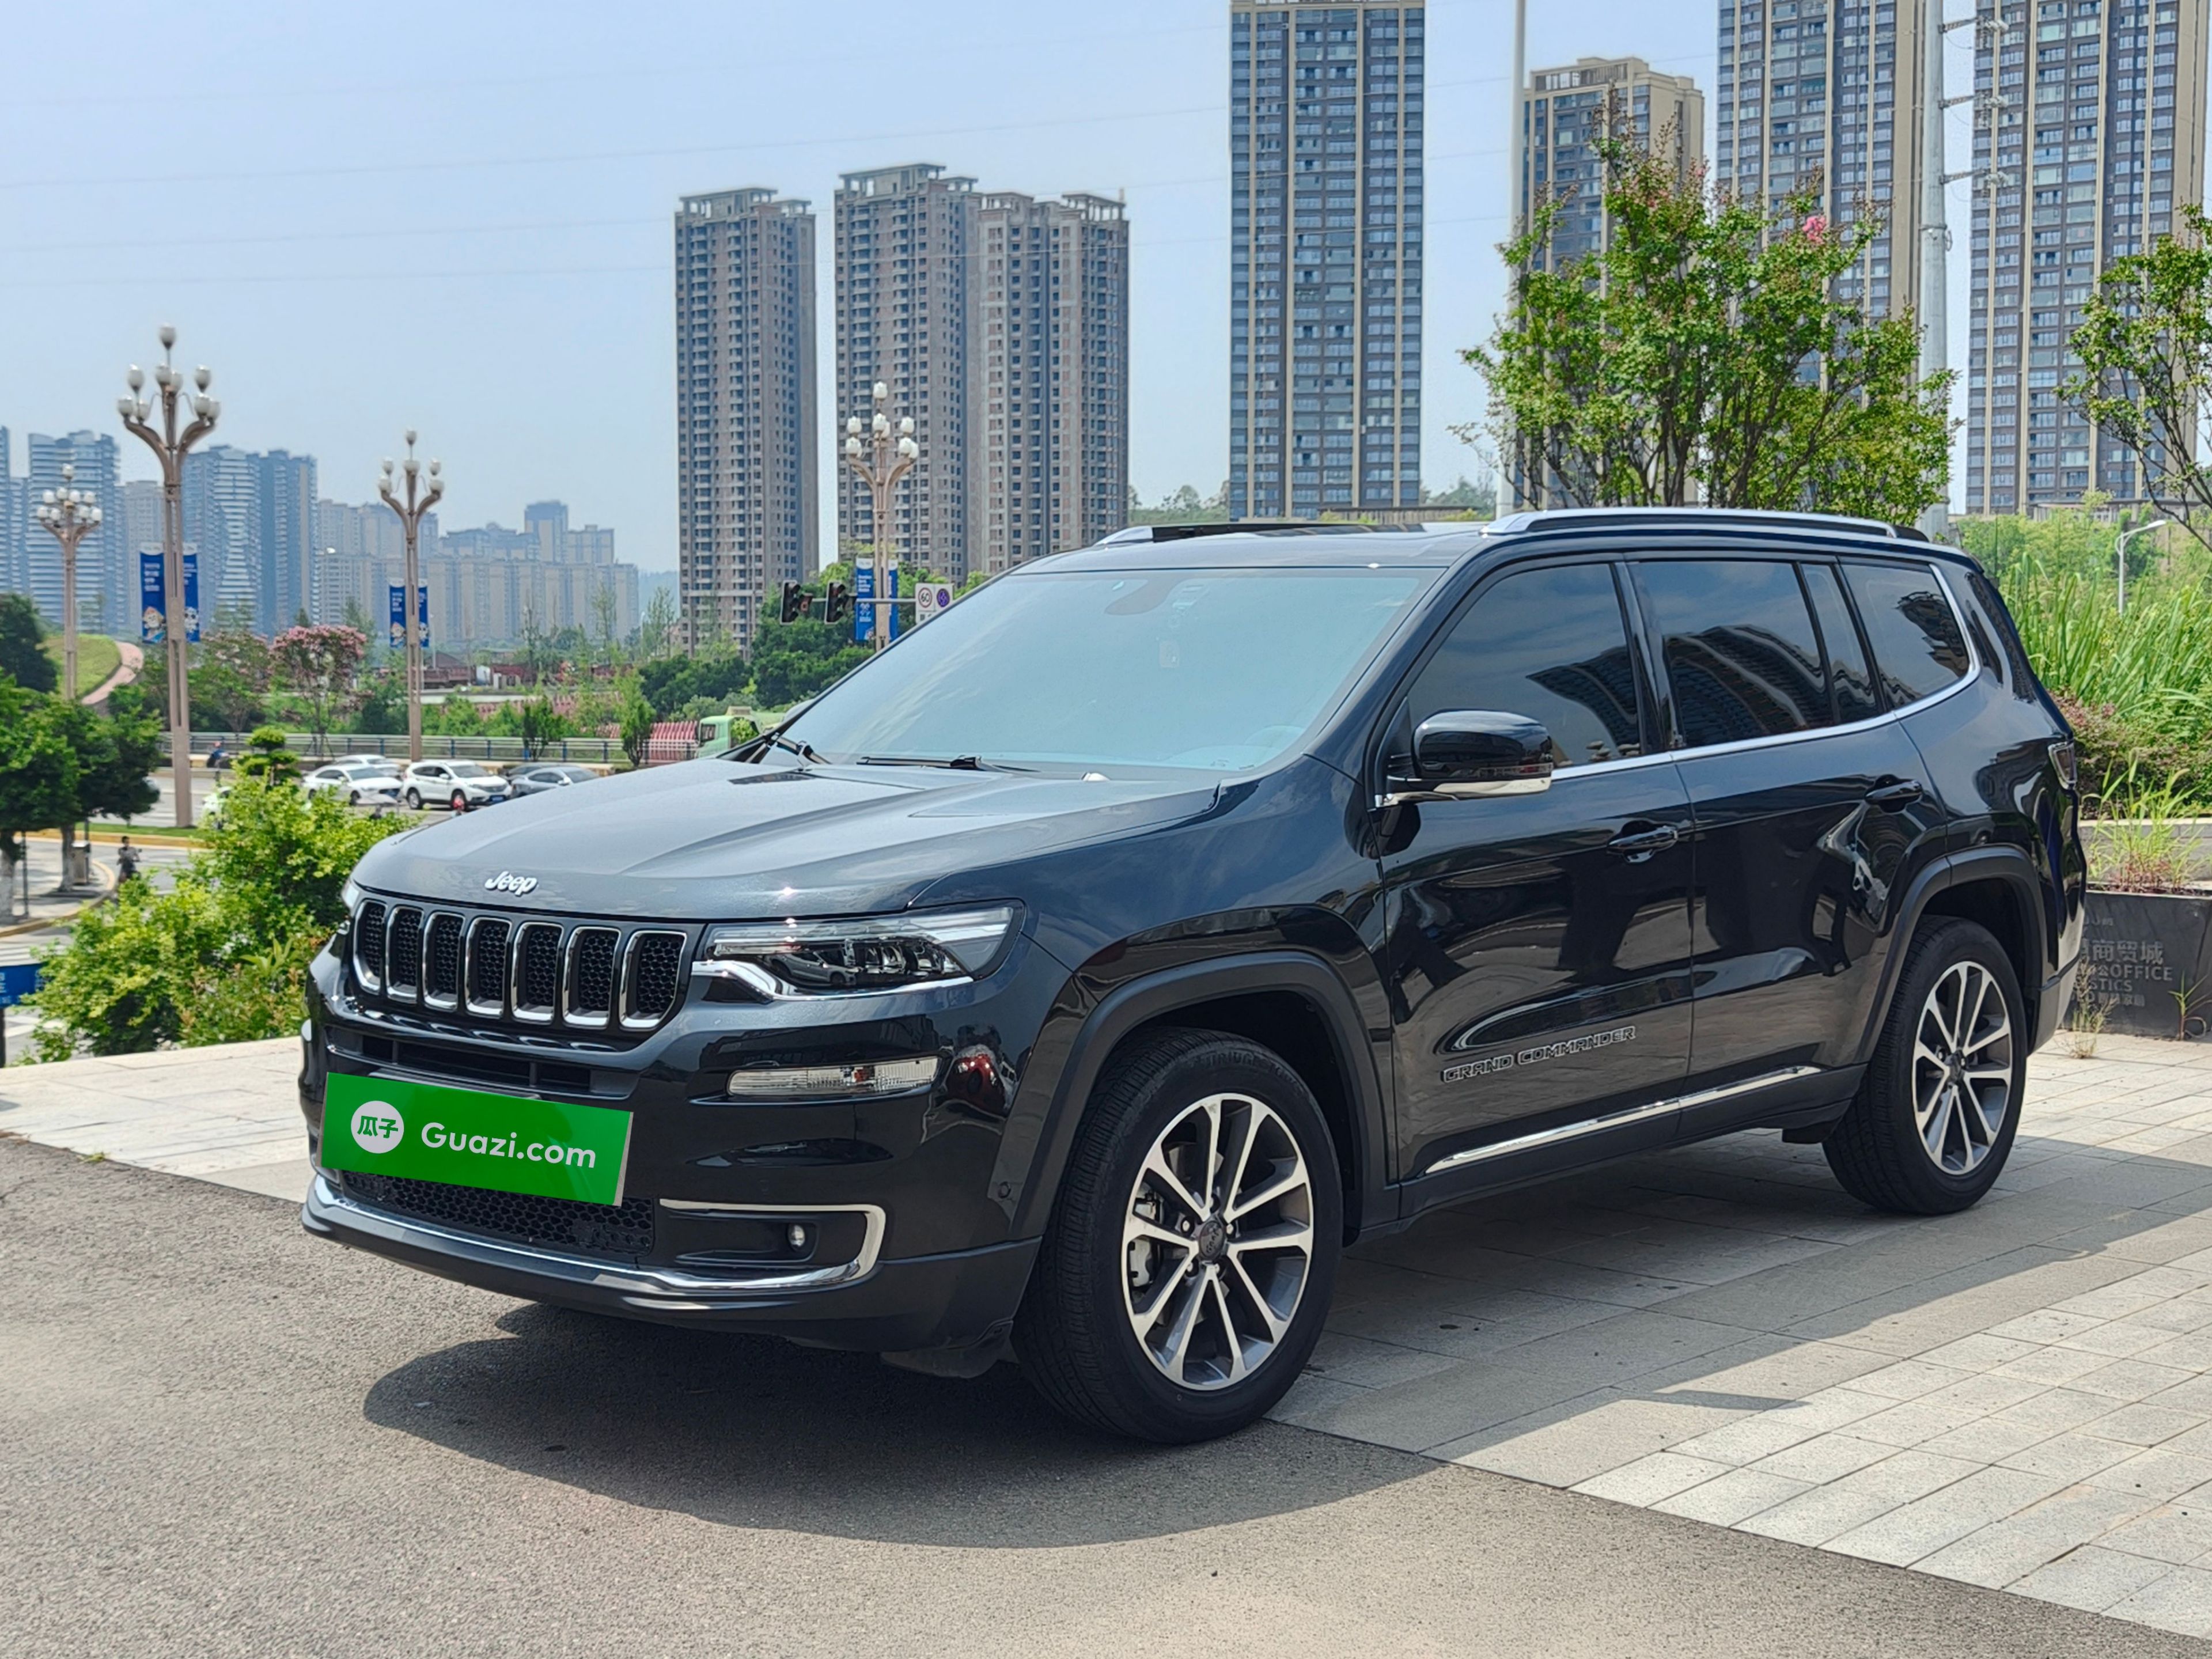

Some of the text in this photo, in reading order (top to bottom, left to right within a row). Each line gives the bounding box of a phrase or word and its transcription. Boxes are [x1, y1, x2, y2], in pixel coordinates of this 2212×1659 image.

[922, 593, 930, 603] 60
[485, 870, 539, 896] Jeep
[2088, 978, 2133, 991] STICS
[2093, 964, 2173, 981] 公OFFICE
[1443, 1025, 1636, 1083] GRAND COMMANDER
[357, 1115, 399, 1139] 瓜子
[421, 1122, 597, 1168] Guazi.com
